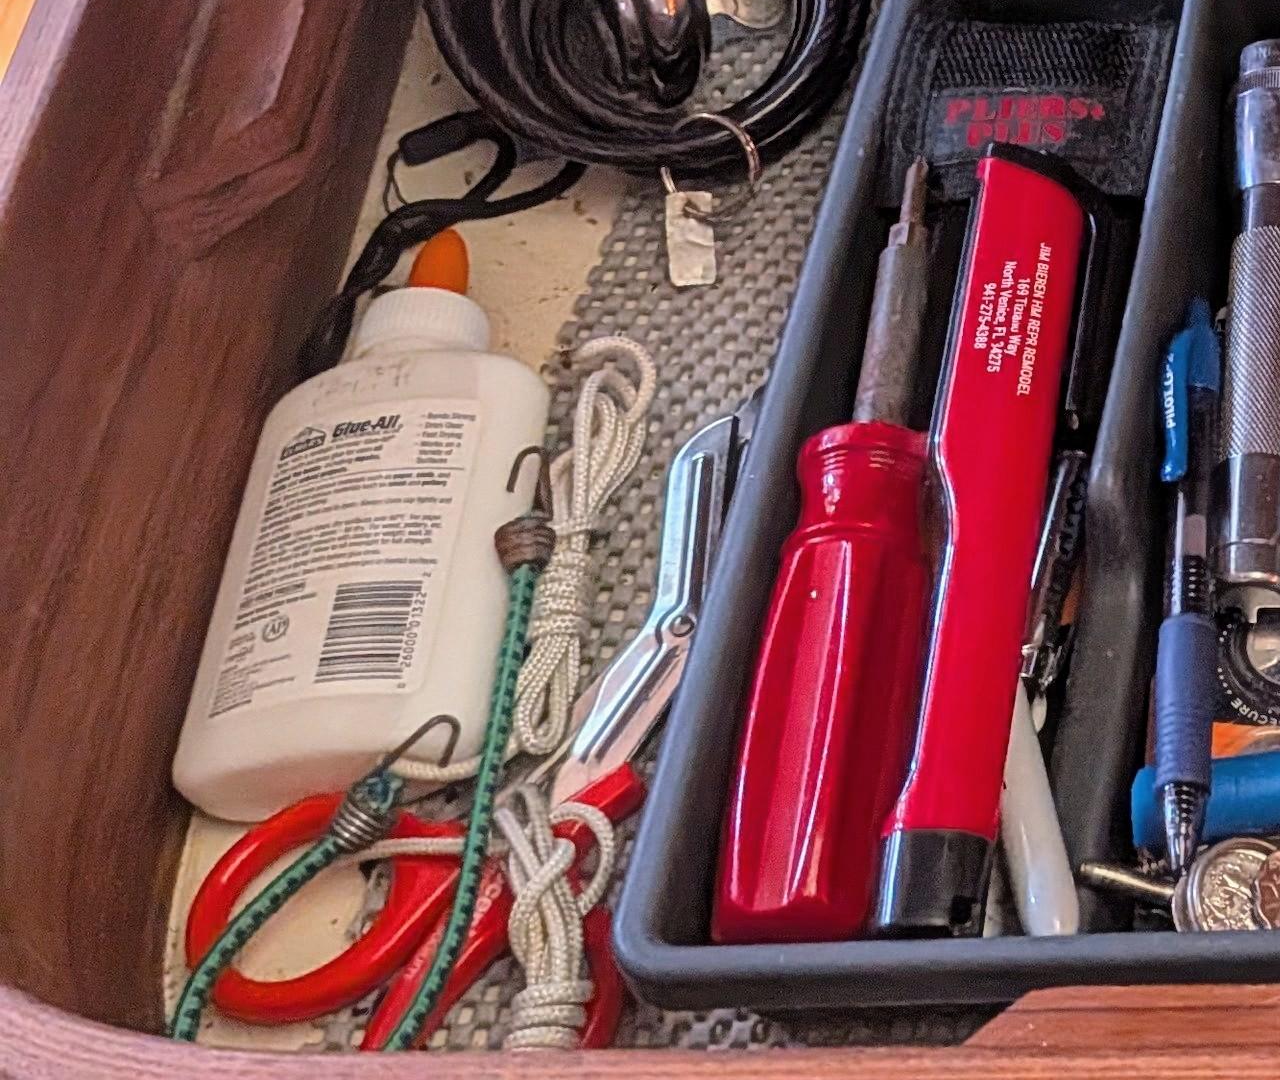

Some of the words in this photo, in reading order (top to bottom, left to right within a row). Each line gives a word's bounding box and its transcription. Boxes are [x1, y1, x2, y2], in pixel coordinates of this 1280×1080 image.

[1038, 242, 1051, 261] JIM
[1001, 261, 1017, 288] North
[1016, 278, 1030, 295] 169
[1032, 263, 1050, 298] BIEREN
[973, 282, 996, 350] 941-275-4388
[993, 290, 1012, 325] Venice,
[992, 326, 1006, 339] FL
[1003, 334, 1021, 356] Way
[1027, 319, 1041, 346] REPR
[987, 341, 1004, 373] 34275
[1016, 347, 1036, 396] REMODEL
[409, 592, 427, 628] 01322
[400, 632, 417, 668] 26000
